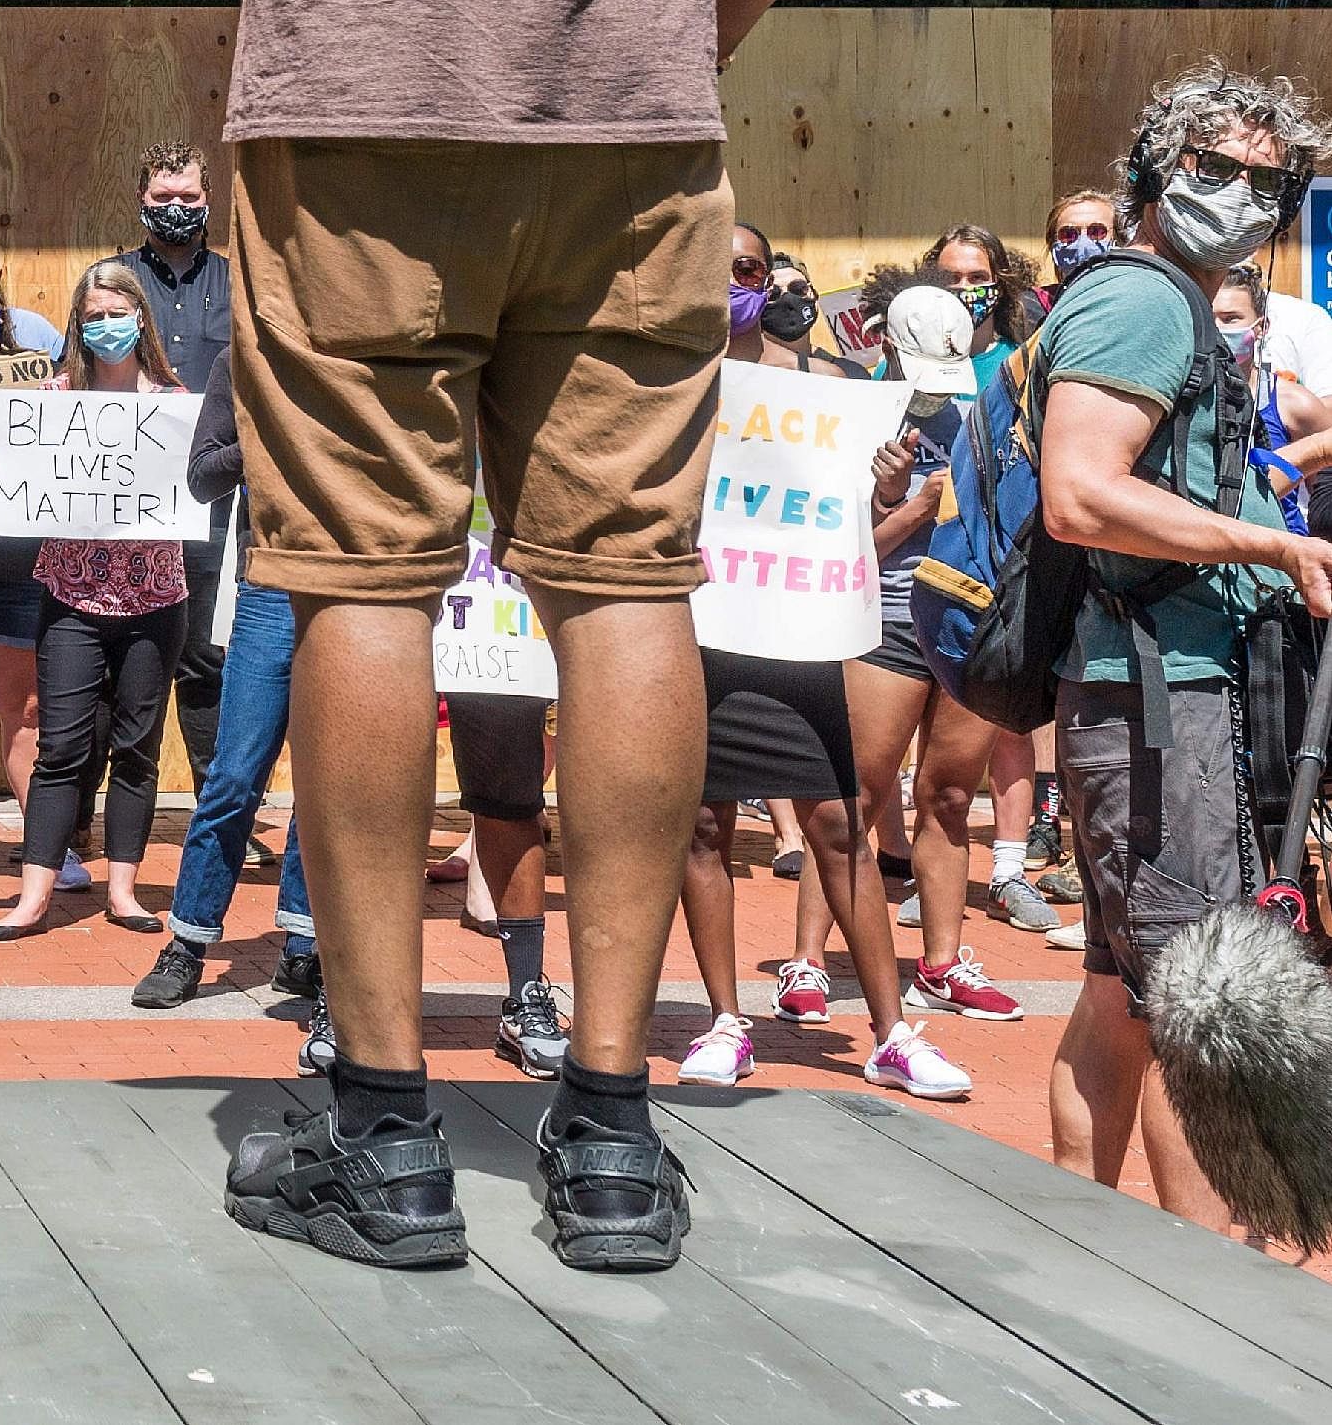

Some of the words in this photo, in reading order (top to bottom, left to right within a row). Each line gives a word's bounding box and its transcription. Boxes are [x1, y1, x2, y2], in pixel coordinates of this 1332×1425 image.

[10, 358, 49, 383] NO
[8, 398, 167, 451] BLACK
[54, 454, 136, 487] LIVES
[582, 1147, 644, 1174] NIKE
